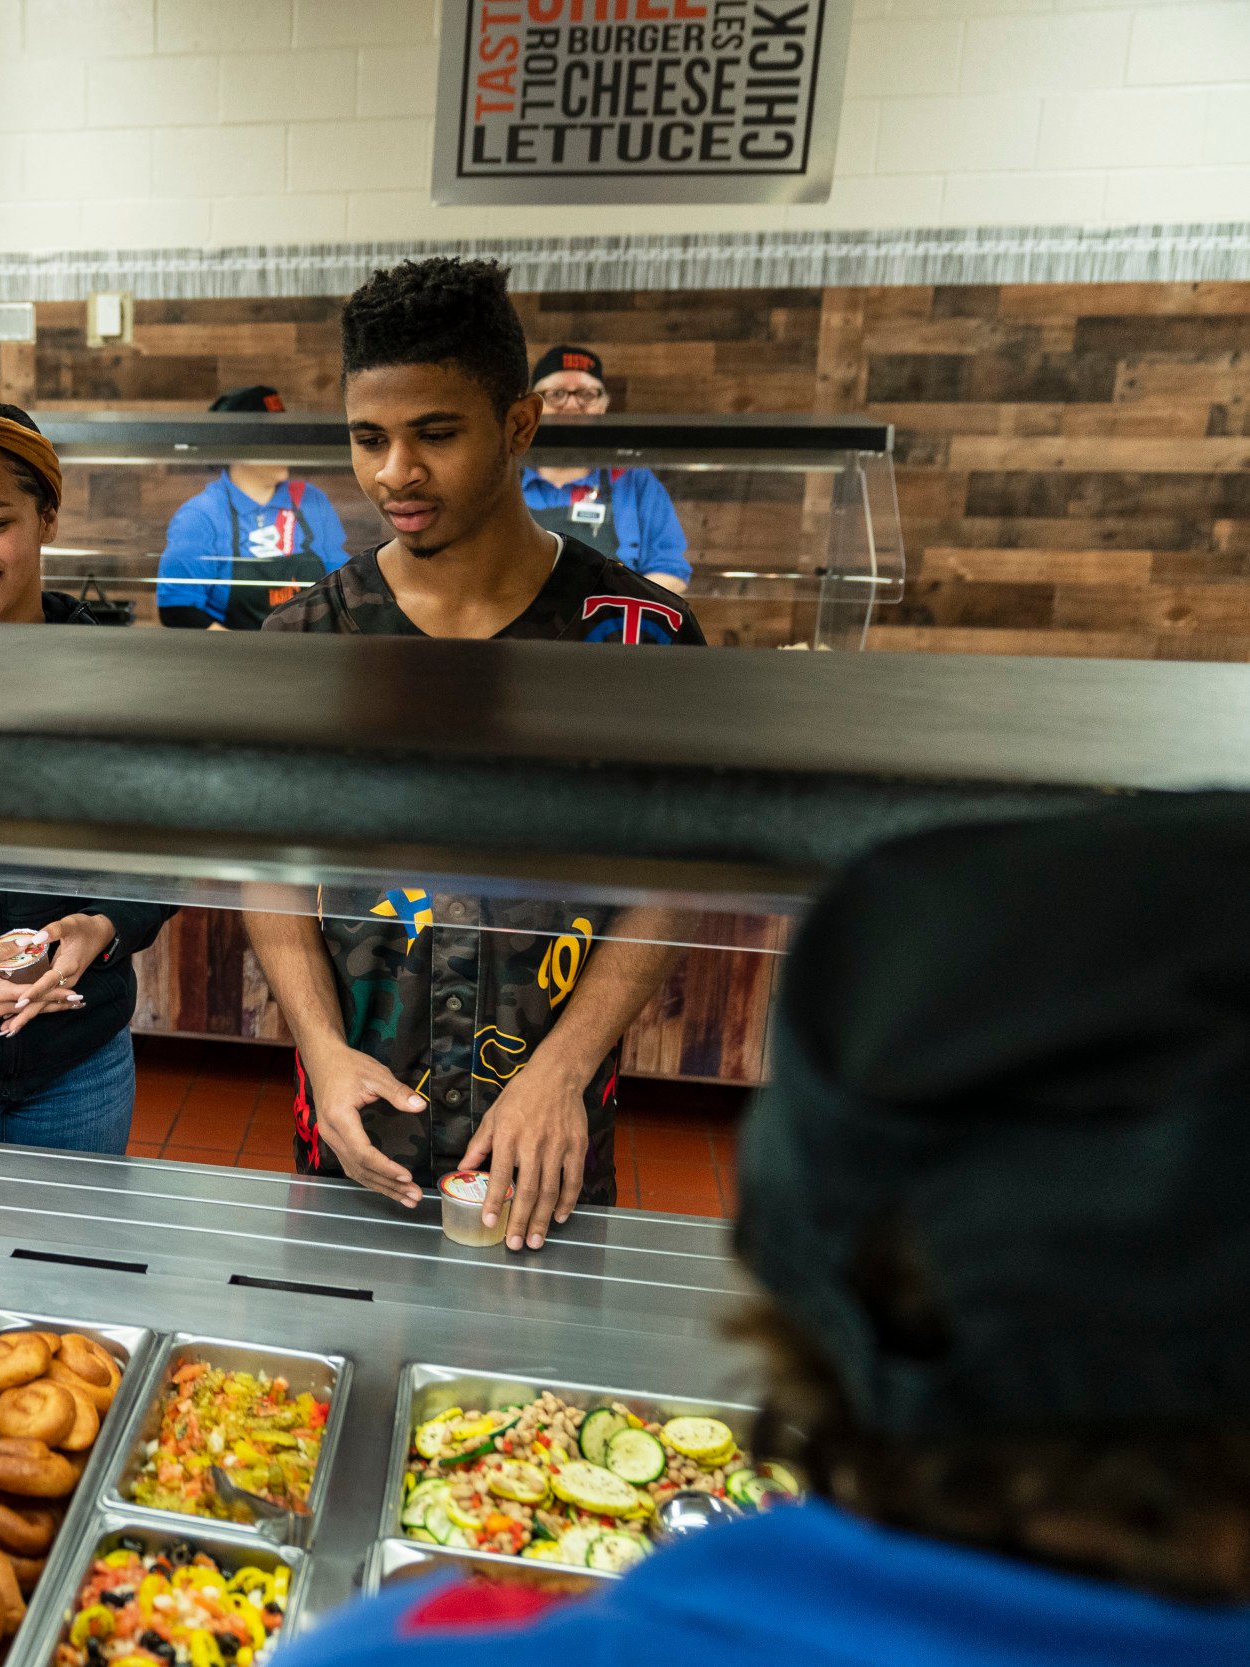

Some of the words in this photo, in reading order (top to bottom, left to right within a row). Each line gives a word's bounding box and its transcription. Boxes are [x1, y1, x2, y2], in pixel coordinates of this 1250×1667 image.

[474, 0, 521, 122] TAST
[520, 27, 560, 119] ROLL
[567, 23, 705, 54] BURGER
[561, 57, 741, 119] CHEESE
[739, 3, 809, 160] CHICK
[471, 120, 735, 165] LETTUCE
